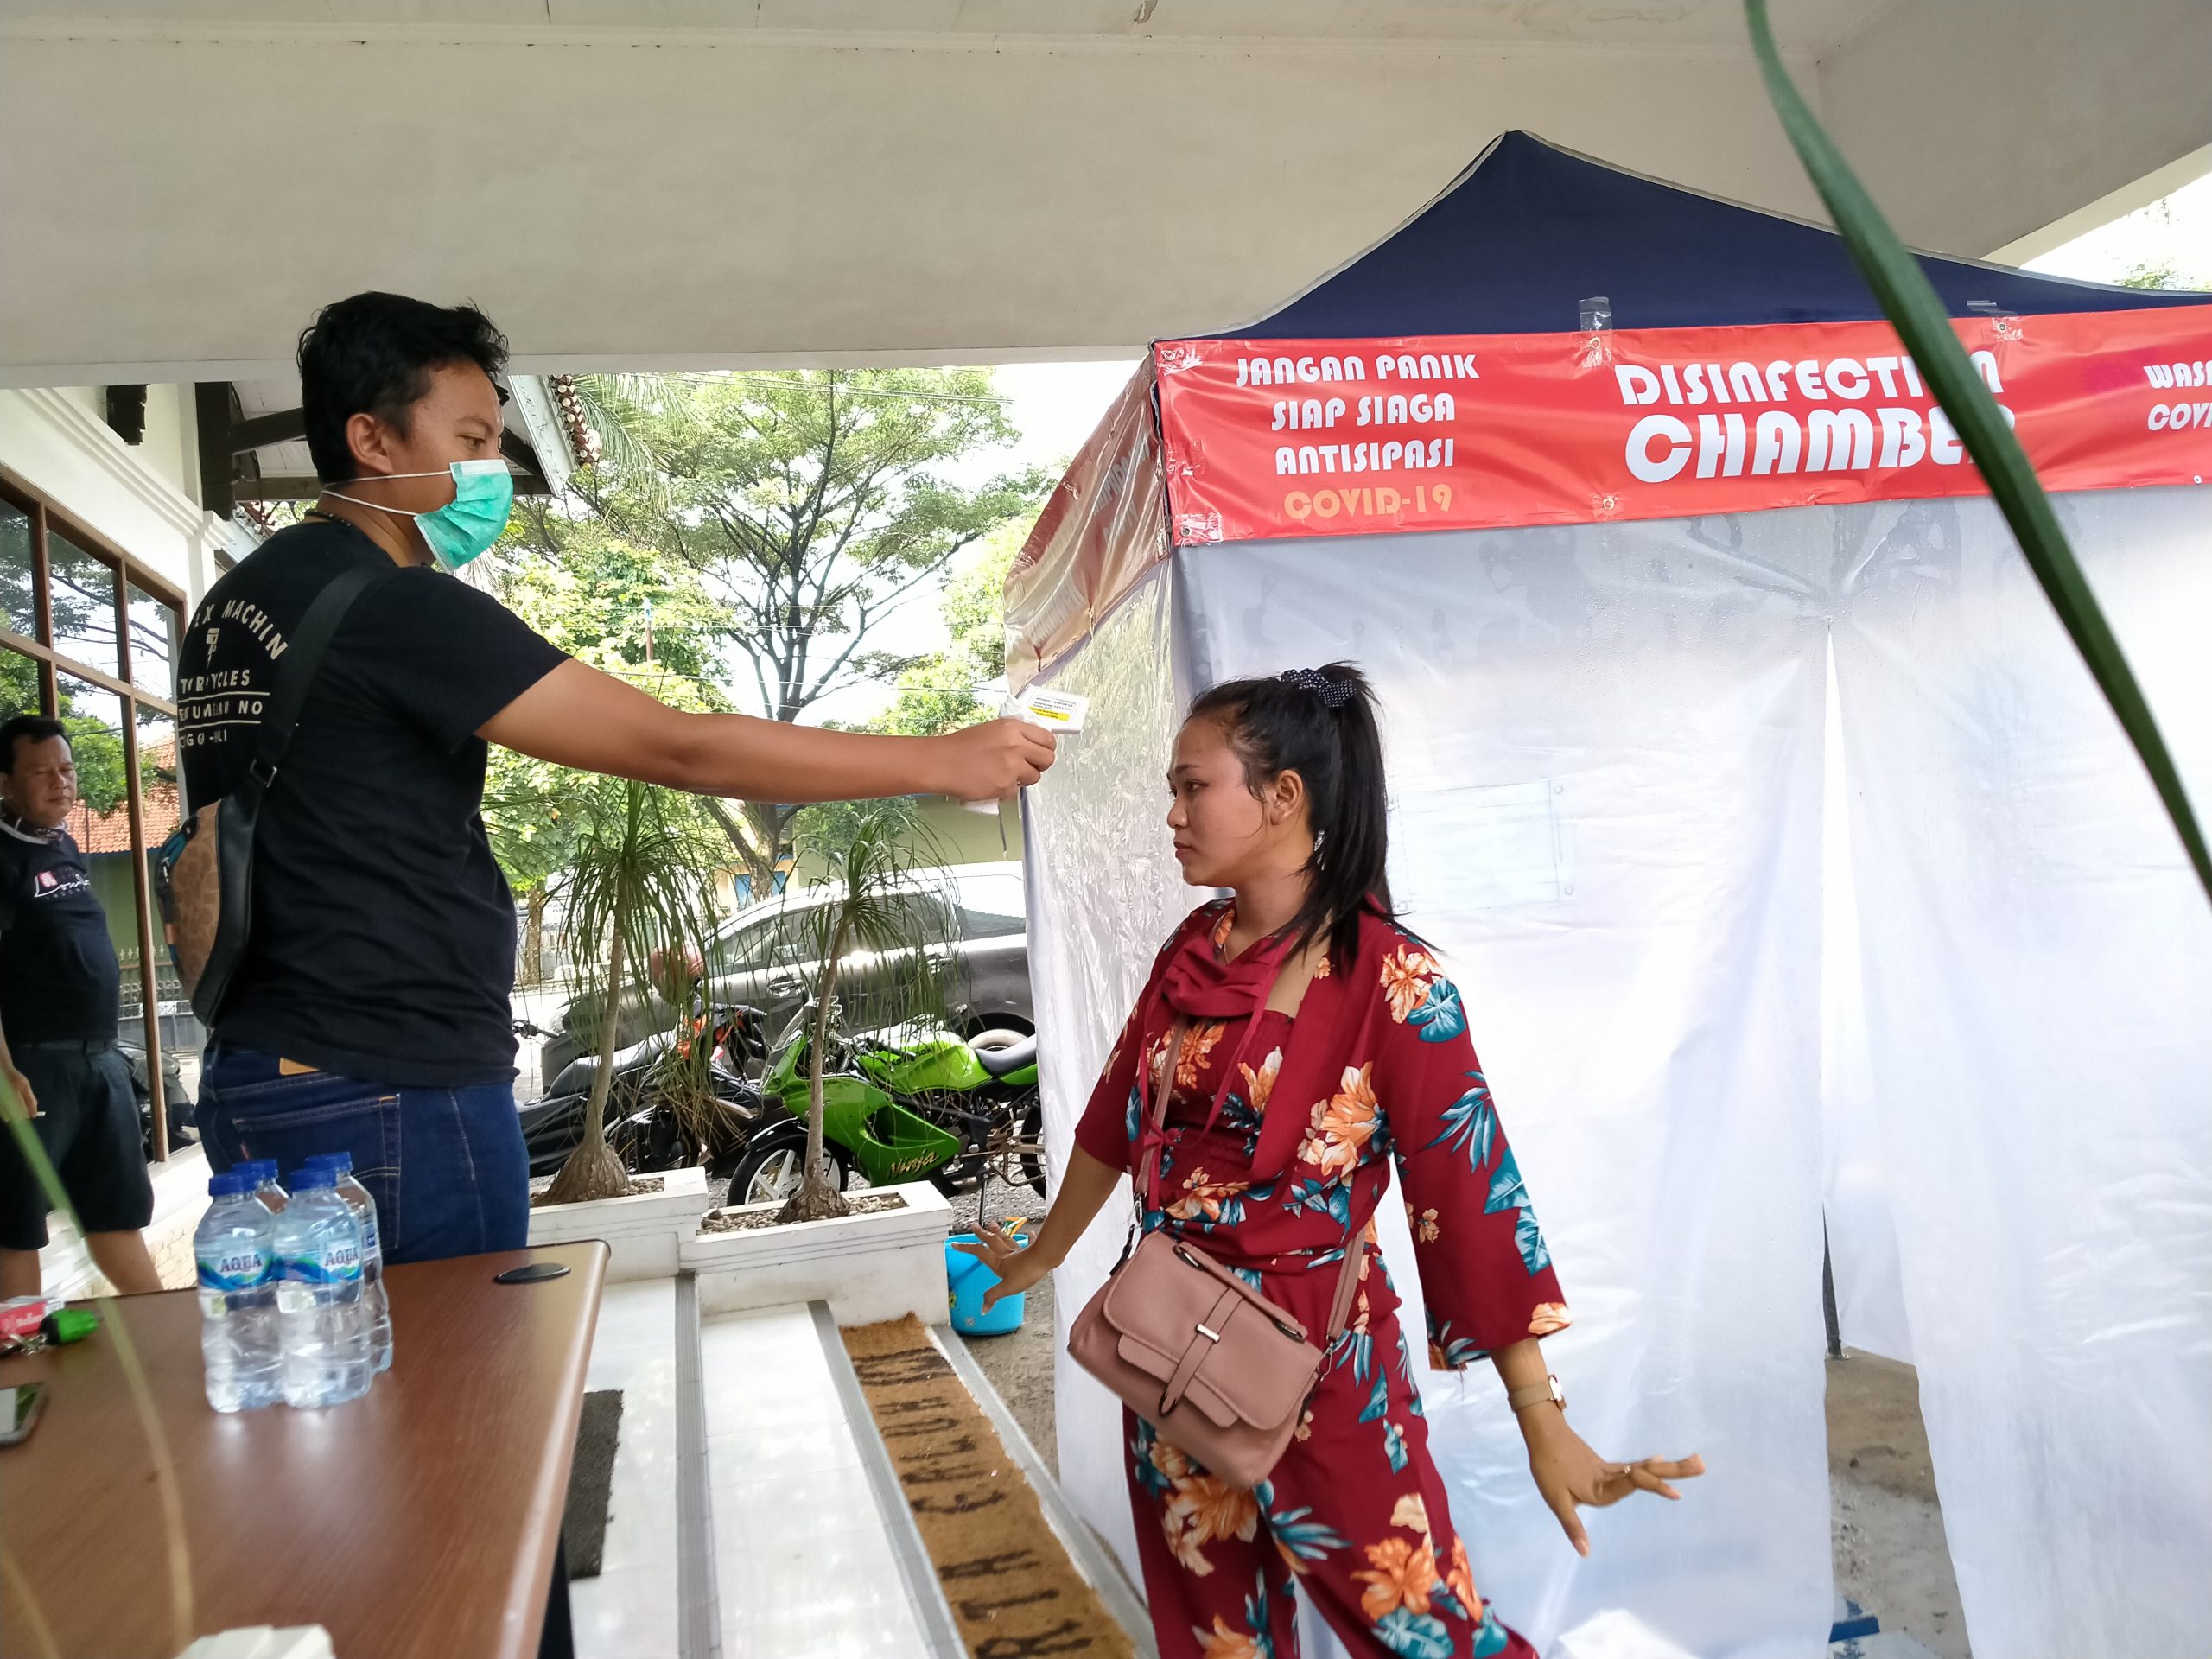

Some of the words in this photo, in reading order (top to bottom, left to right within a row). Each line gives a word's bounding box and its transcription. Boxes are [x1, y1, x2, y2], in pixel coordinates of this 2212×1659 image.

[1236, 355, 1366, 387] JANGAN
[1376, 353, 1480, 381] PANIK
[1614, 350, 2005, 405] DISINFECTIN
[1272, 397, 1345, 431] SIAP
[1357, 392, 1456, 427] SIAGA
[1276, 438, 1454, 475] ANTISIPASI
[1624, 408, 2015, 483] CHAMBE
[1284, 483, 1452, 519] COVID-19
[889, 1148, 941, 1178] Ninja
[220, 1253, 263, 1274] AQUA
[325, 1248, 359, 1267] AQUA
